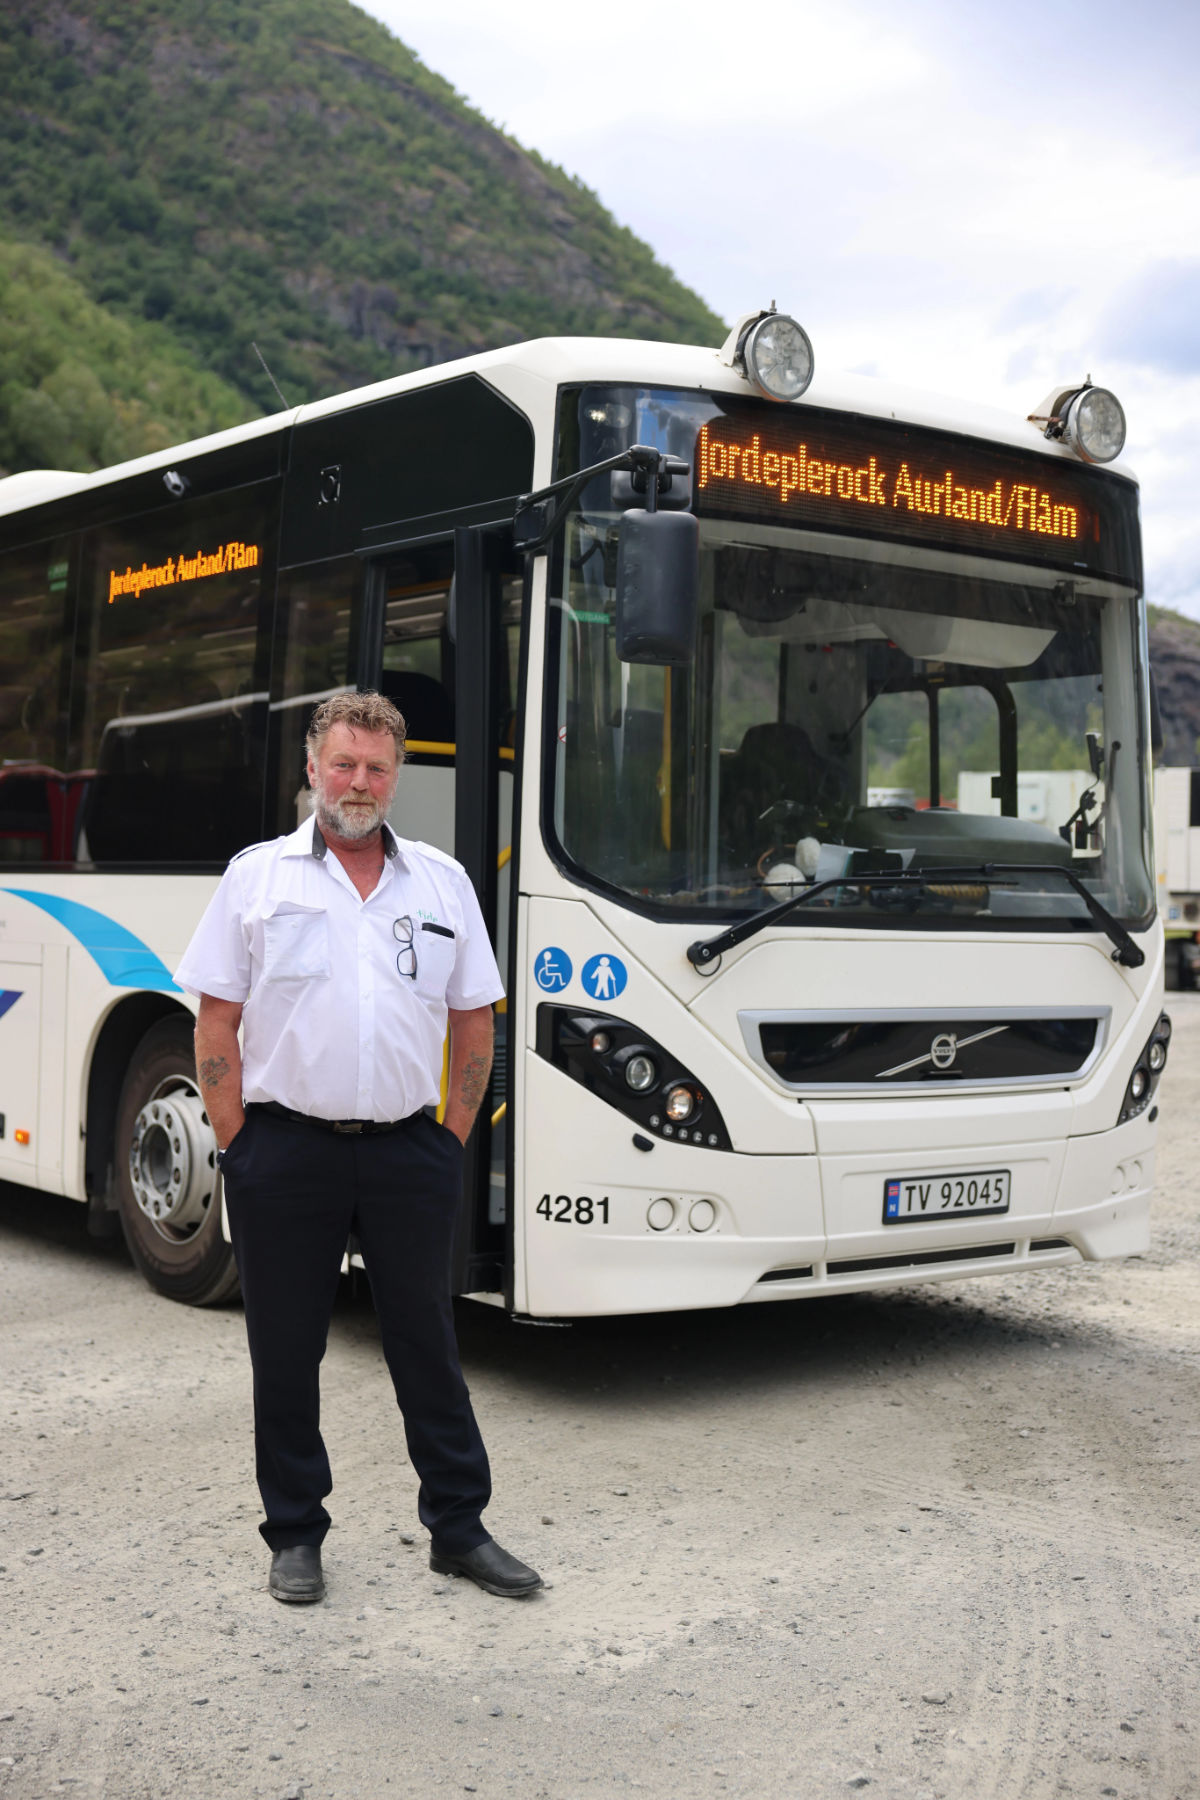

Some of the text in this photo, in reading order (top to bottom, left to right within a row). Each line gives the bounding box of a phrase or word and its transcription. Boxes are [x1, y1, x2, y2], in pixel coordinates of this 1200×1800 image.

[893, 463, 1078, 538] Aurland/Flåm
[536, 1194, 609, 1225] 4281
[905, 1178, 1003, 1212] TV 92045
